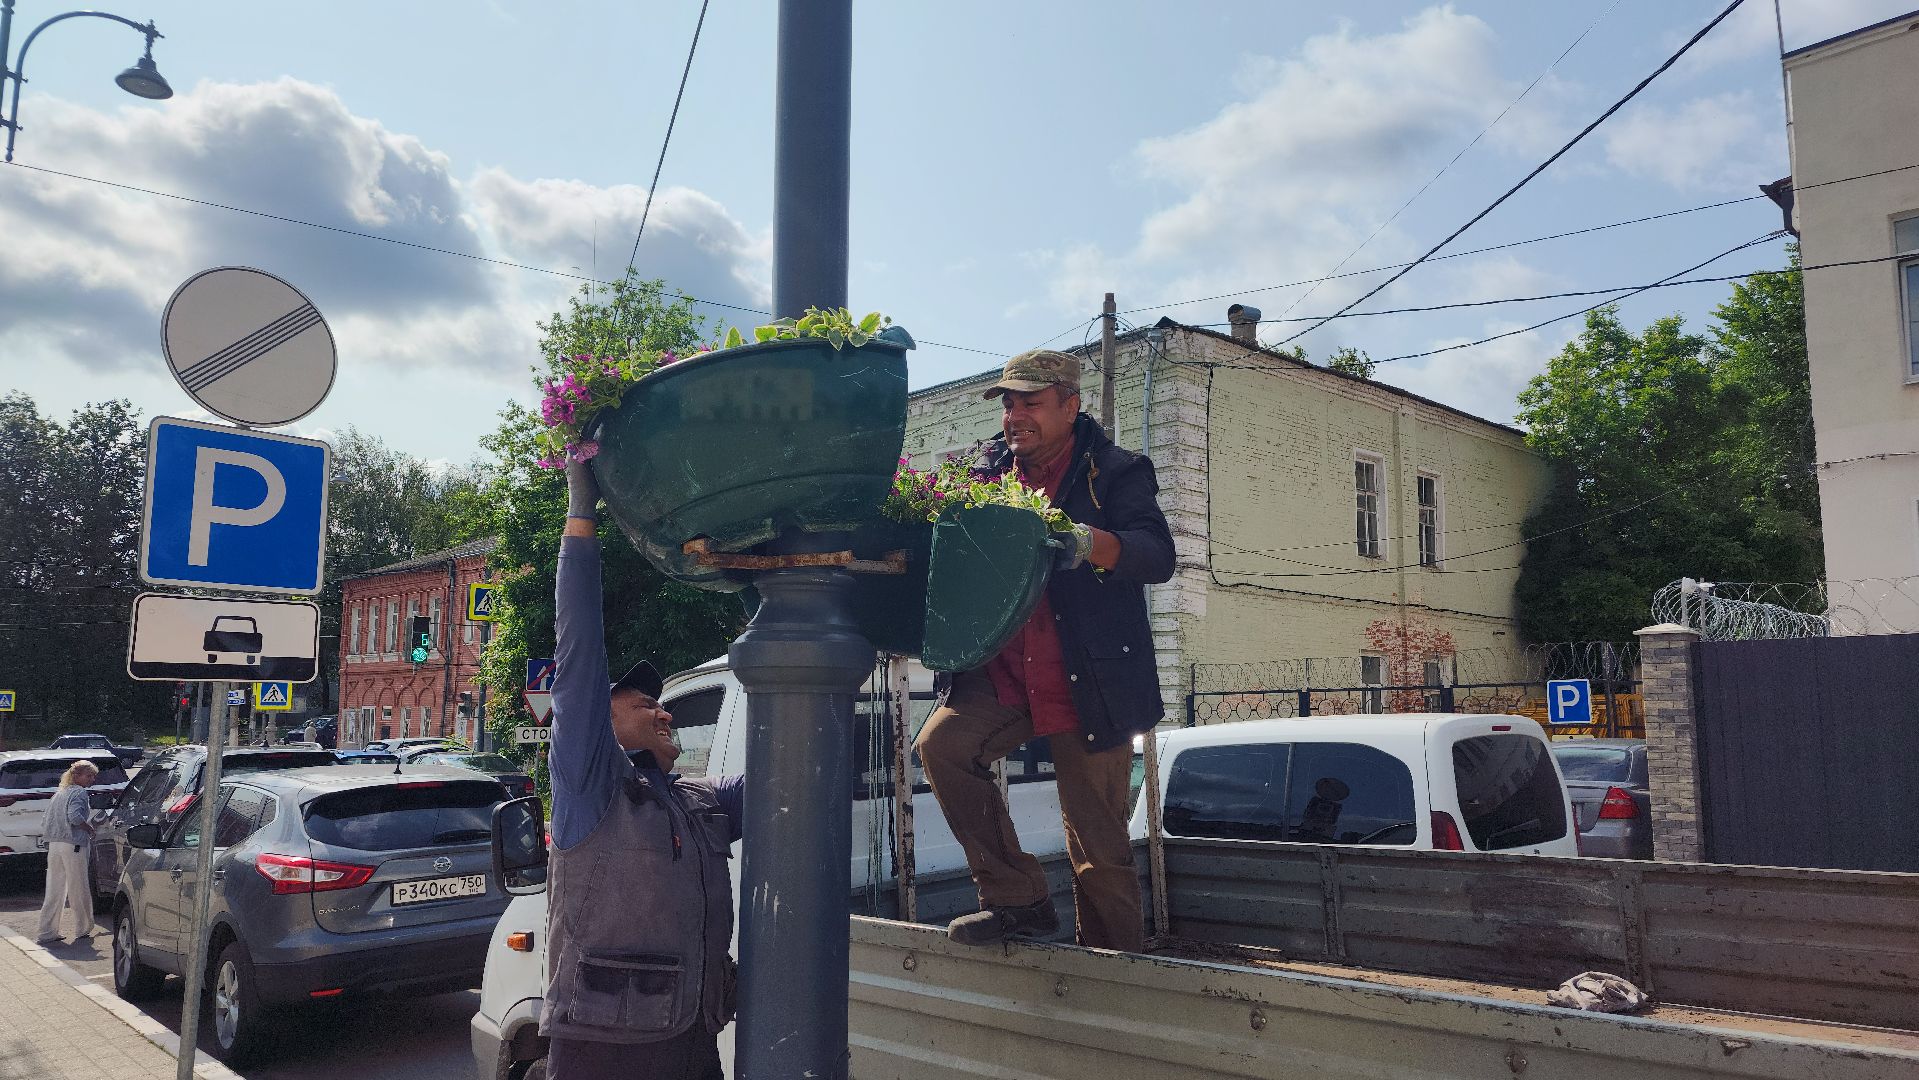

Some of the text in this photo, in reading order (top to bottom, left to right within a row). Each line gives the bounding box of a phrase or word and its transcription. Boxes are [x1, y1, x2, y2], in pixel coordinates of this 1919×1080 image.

[188, 446, 287, 567] P
[1557, 685, 1580, 719] P
[522, 728, 552, 740] СТО
[461, 876, 482, 890] 750
